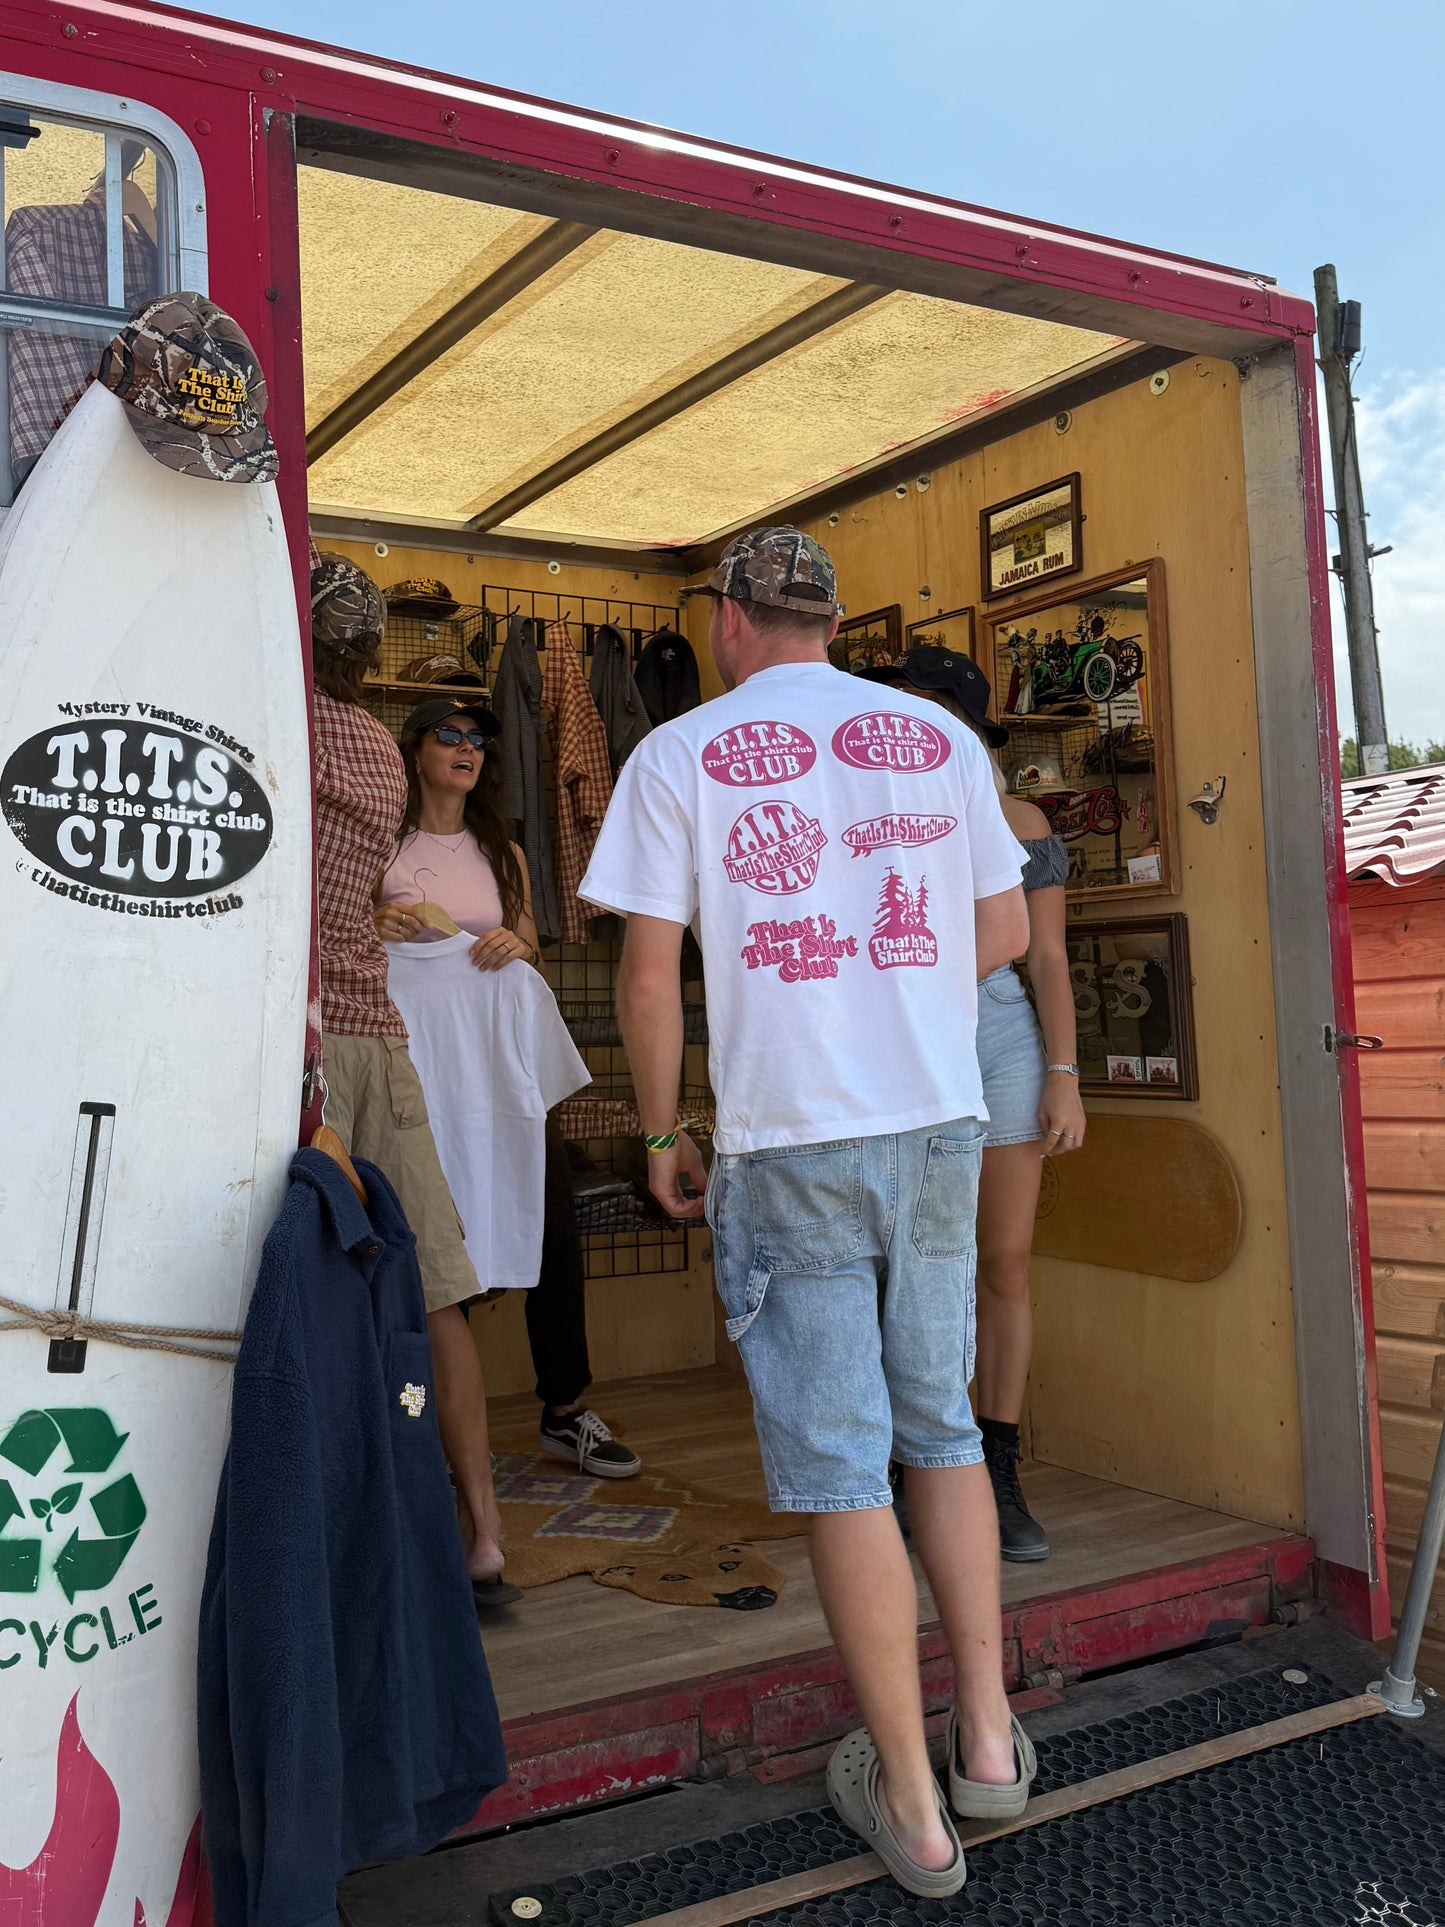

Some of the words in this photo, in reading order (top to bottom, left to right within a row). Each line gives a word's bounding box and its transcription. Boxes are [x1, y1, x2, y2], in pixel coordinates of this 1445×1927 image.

[178, 378, 212, 397] The
[215, 386, 247, 402] Shir
[188, 367, 230, 388] That
[231, 375, 244, 389] Is
[198, 396, 234, 414] Club
[999, 561, 1039, 586] JAMAICA
[1042, 551, 1064, 571] RUM
[57, 701, 130, 717] Mystery
[136, 702, 203, 733] Vintage
[204, 724, 255, 763] Shirts
[713, 723, 801, 756] T.I.T.S.
[847, 738, 871, 748] That
[882, 736, 896, 746] the
[897, 739, 918, 747] shirt
[920, 741, 937, 750] club
[856, 715, 929, 741] T.I.T.S.
[46, 729, 243, 808] T.I.T.S.
[705, 757, 731, 769] That
[732, 753, 742, 761] is
[744, 750, 762, 759] the
[764, 746, 789, 756] shirt
[791, 745, 813, 754] club
[728, 754, 802, 783] CLUB
[867, 743, 926, 767] CLUB
[11, 784, 72, 810] That
[77, 793, 100, 813] is
[105, 797, 146, 818] the
[151, 804, 210, 826] shirt
[214, 812, 266, 831] club
[56, 814, 224, 882] CLUB
[15, 857, 244, 918] thatistheshirtclub
[755, 856, 816, 892] CLUB
[747, 915, 818, 945] That
[817, 913, 837, 938] Is
[871, 934, 910, 953] That
[911, 933, 920, 949] Is
[919, 934, 936, 950] The
[741, 942, 796, 970] The
[798, 934, 859, 959] Shirt
[877, 947, 915, 967] Shirt
[915, 947, 936, 963] Club
[778, 955, 839, 983] Club
[0, 1582, 163, 1669] CYCLE
